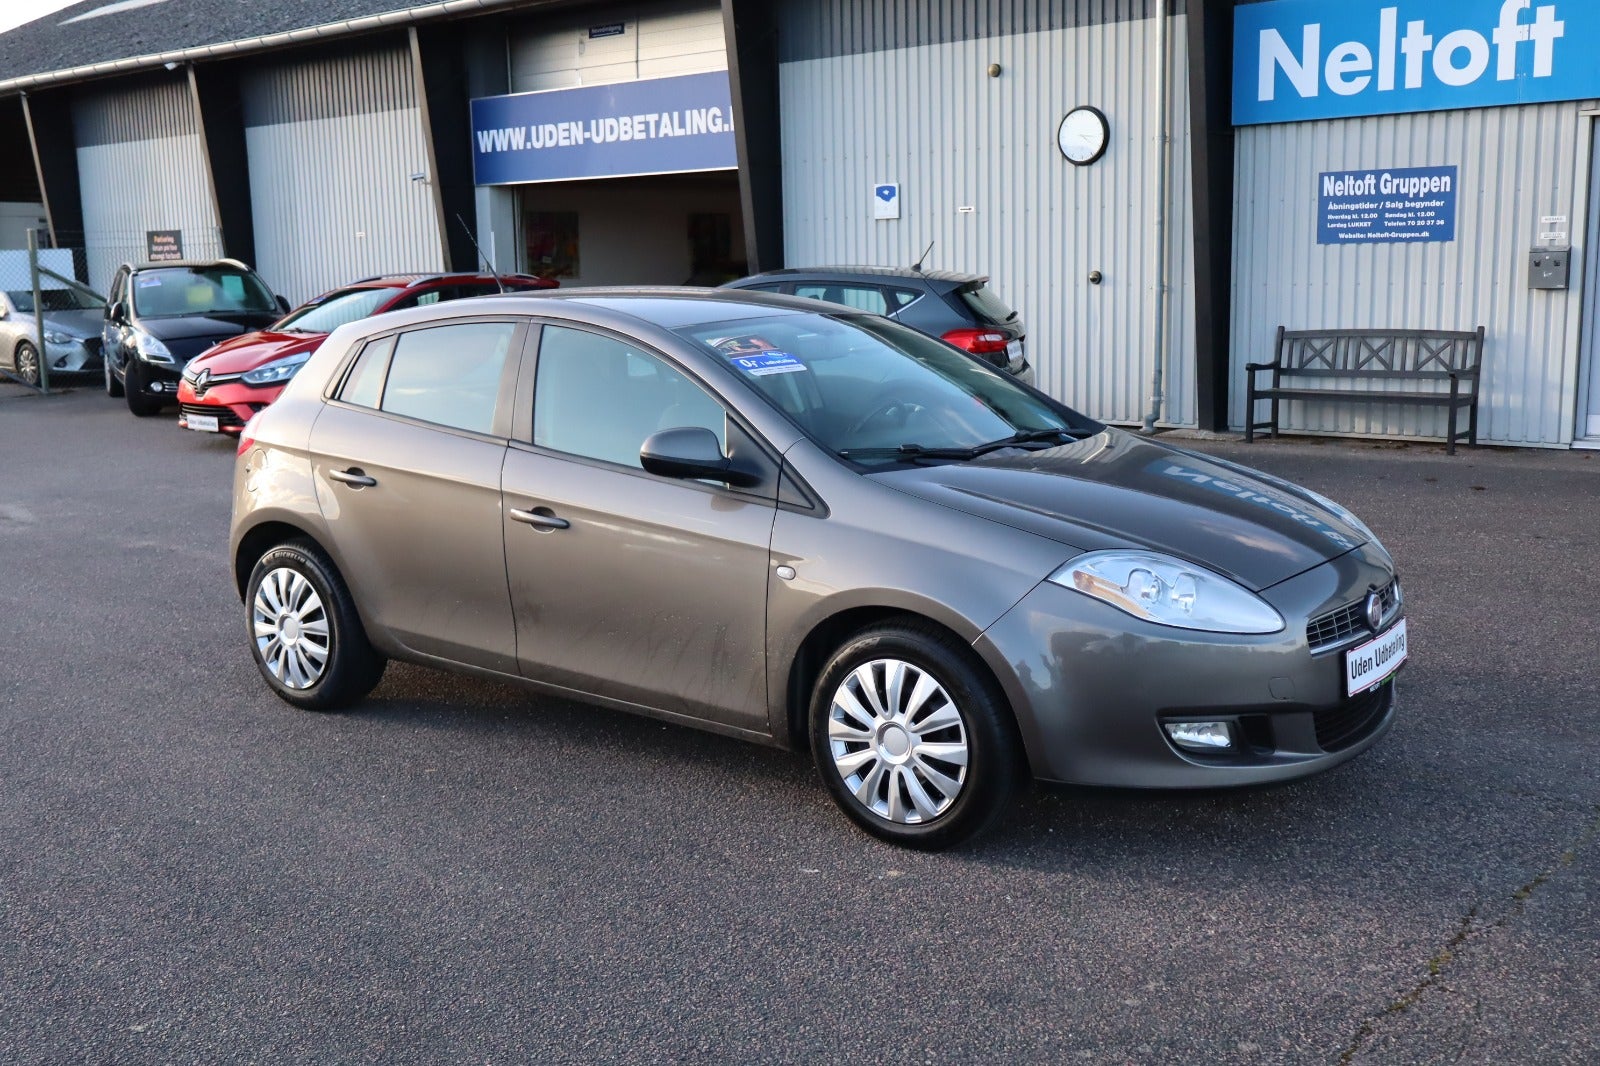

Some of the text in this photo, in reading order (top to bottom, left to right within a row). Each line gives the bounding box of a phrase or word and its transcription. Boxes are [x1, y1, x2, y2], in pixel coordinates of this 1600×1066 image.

[1258, 0, 1564, 102] Neltoft
[1323, 172, 1451, 198] Neltoft Gruppen
[1328, 202, 1378, 211] Åbningstider
[1385, 201, 1404, 209] Salg
[1405, 199, 1445, 209] begynder
[1351, 633, 1405, 680] Uden Udbetaling
